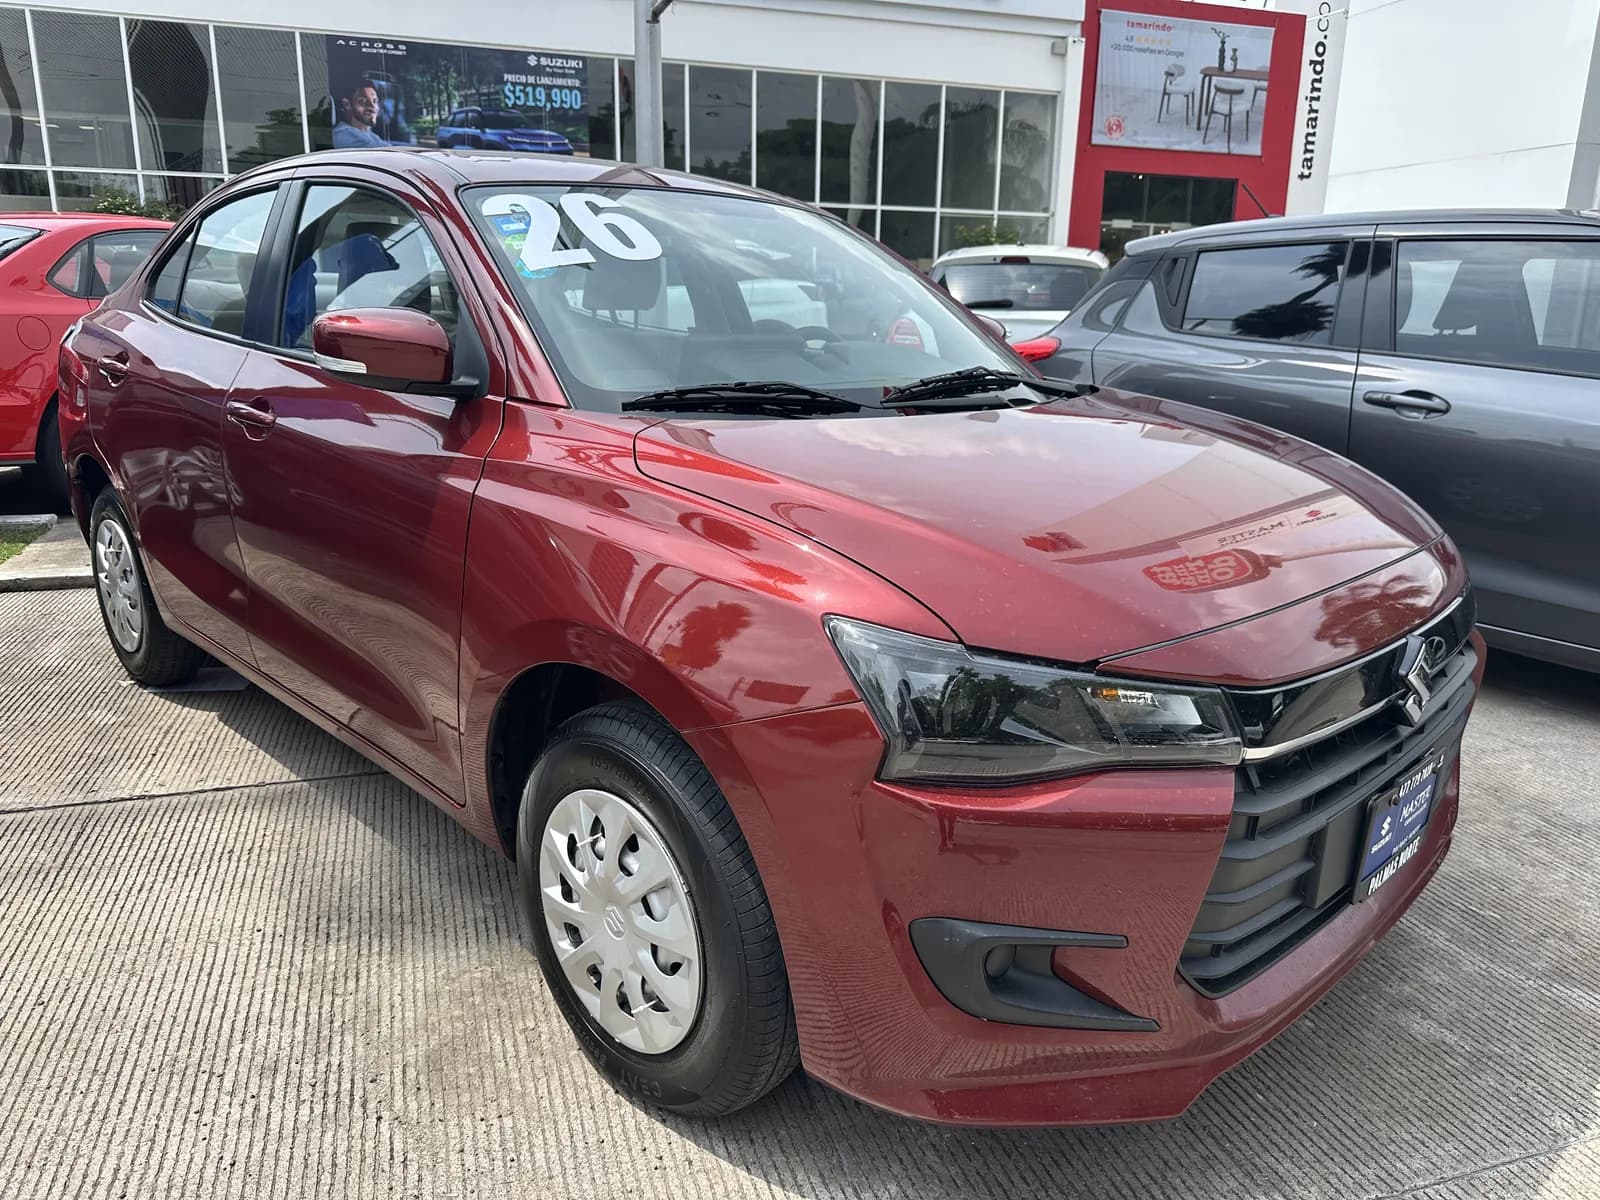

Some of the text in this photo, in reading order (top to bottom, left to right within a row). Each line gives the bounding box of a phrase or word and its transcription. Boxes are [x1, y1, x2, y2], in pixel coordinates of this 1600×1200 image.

[1126, 19, 1173, 32] tamarindo
[336, 40, 407, 50] ACROSS
[539, 56, 583, 68] SUZUKI
[503, 73, 526, 83] PRECIO
[527, 75, 536, 84] DE
[503, 82, 582, 112] $519,990
[481, 192, 663, 271] 26
[1367, 859, 1399, 896] PALMAS
